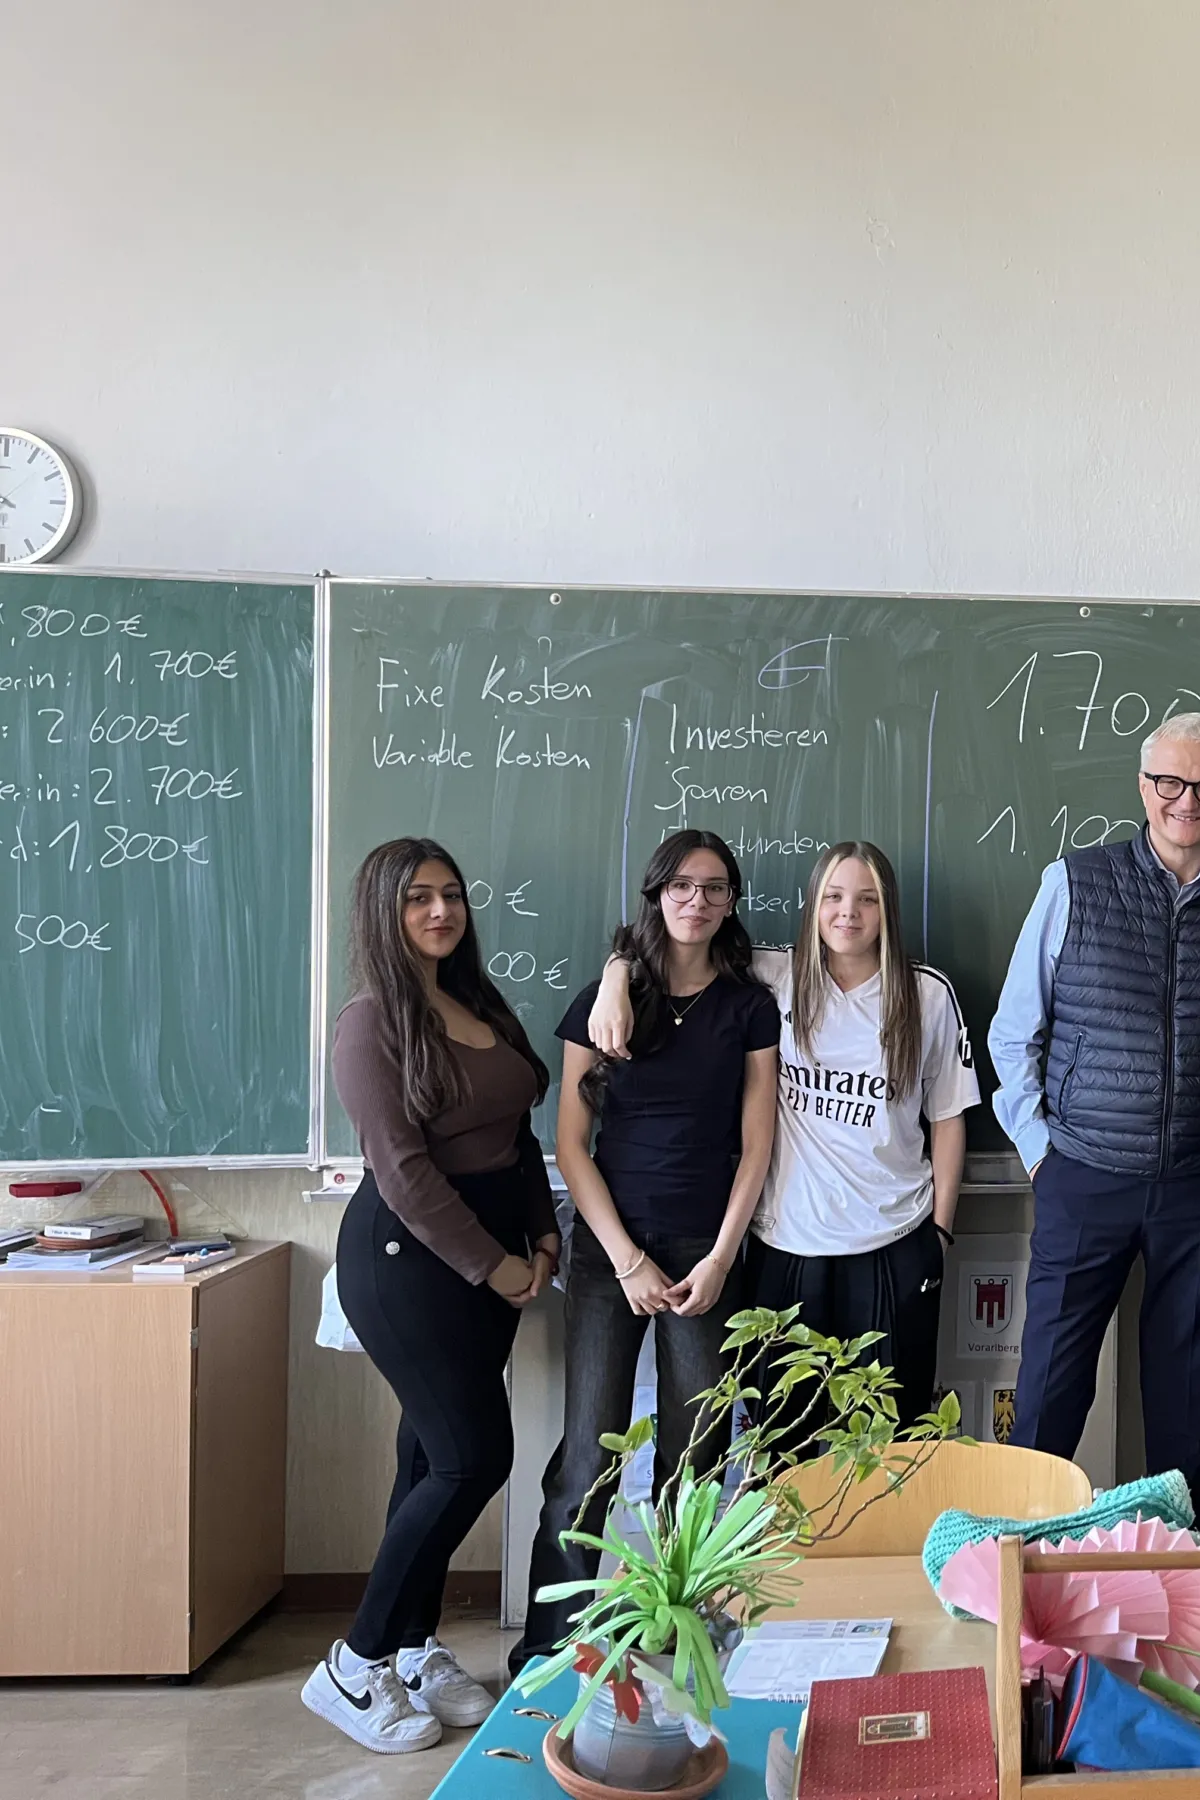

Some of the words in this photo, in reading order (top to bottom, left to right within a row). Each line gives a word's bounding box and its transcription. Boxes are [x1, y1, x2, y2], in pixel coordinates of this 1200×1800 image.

[376, 656, 444, 713] Fixe
[481, 655, 593, 705] Kosten
[373, 729, 474, 769] Variable
[496, 725, 592, 770] Kosten
[669, 703, 829, 754] Investieren
[653, 765, 769, 816] Sparen
[14, 913, 112, 953] 500€
[787, 1086, 810, 1113] FLY
[815, 1095, 877, 1128] BETTER
[967, 1342, 1020, 1354] Vorarlberg
